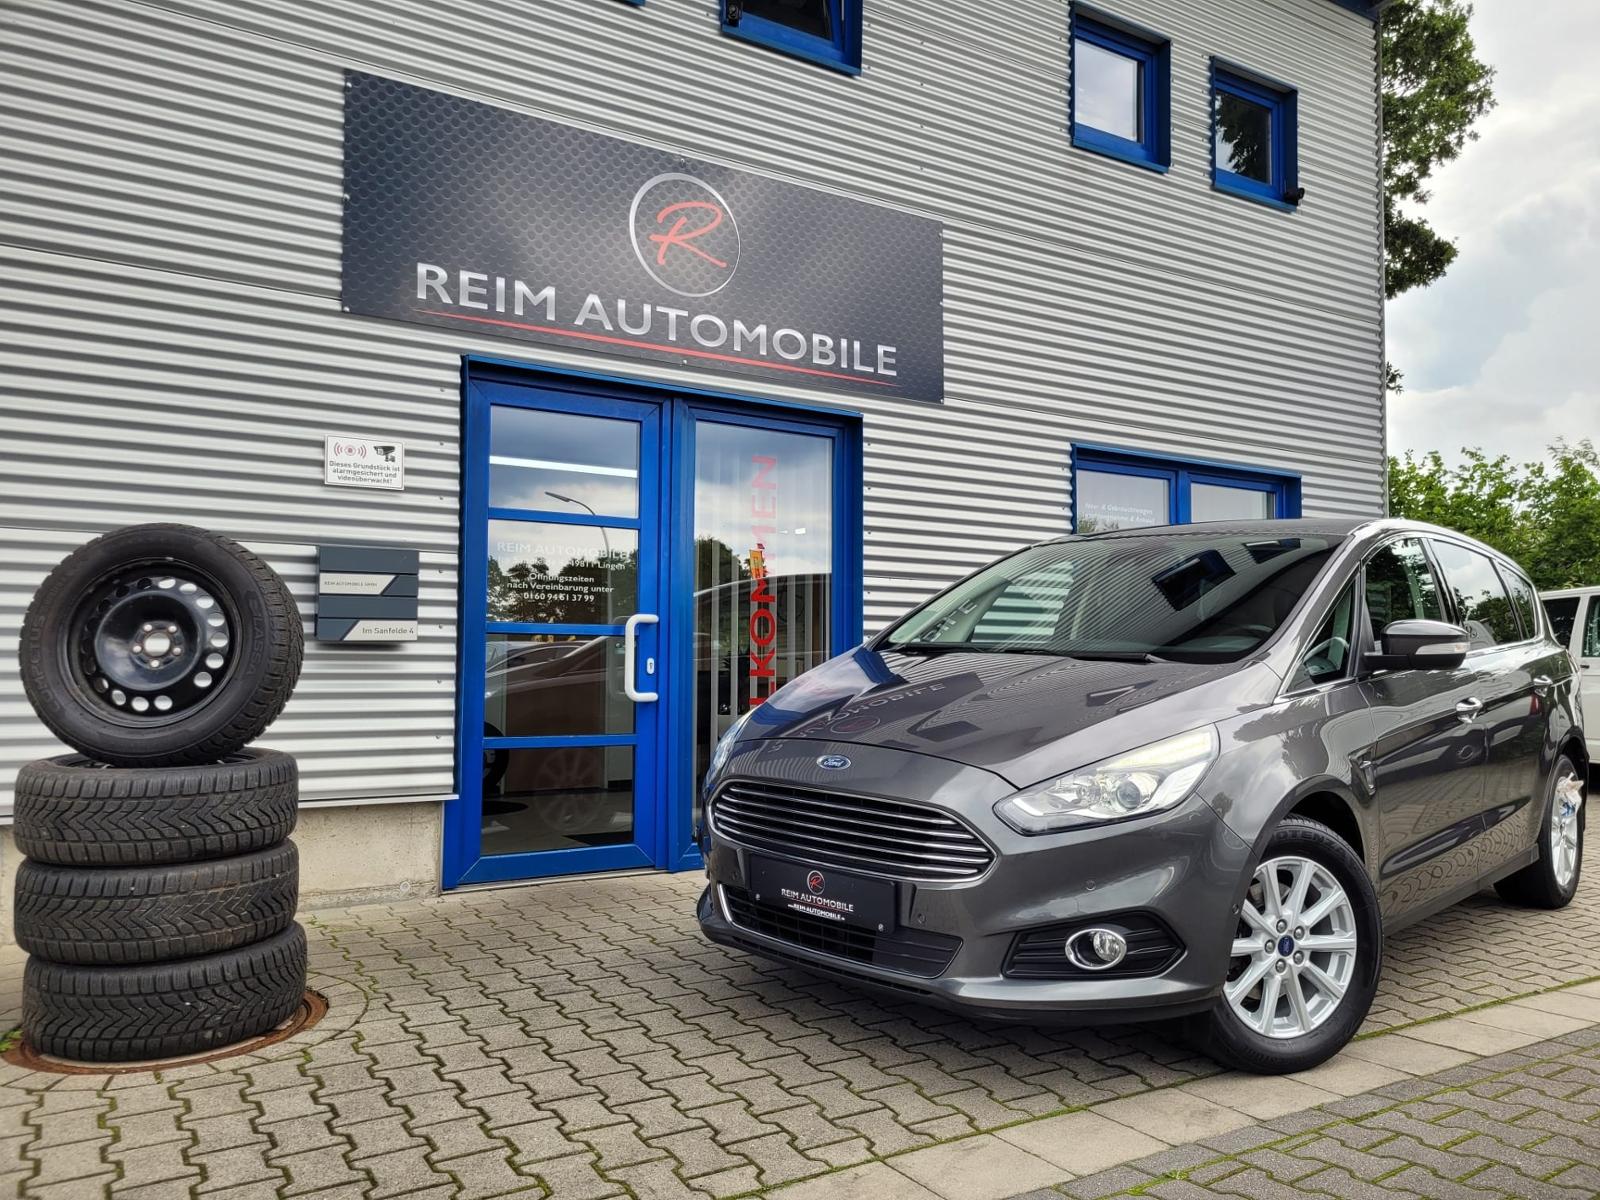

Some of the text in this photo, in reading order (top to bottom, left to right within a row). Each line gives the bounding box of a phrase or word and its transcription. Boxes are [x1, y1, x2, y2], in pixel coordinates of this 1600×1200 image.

[649, 201, 728, 267] R
[416, 262, 898, 376] REIM AUTOMOBILE
[329, 460, 353, 469] Dieses
[353, 462, 391, 471] Grundstück
[332, 468, 384, 477] alarmgesichert
[497, 542, 629, 560] REIM AUTOMOBILE
[506, 581, 528, 590] nach
[529, 582, 589, 593] Vereinbarung
[781, 888, 854, 912] REIM AUTOMOBILE
